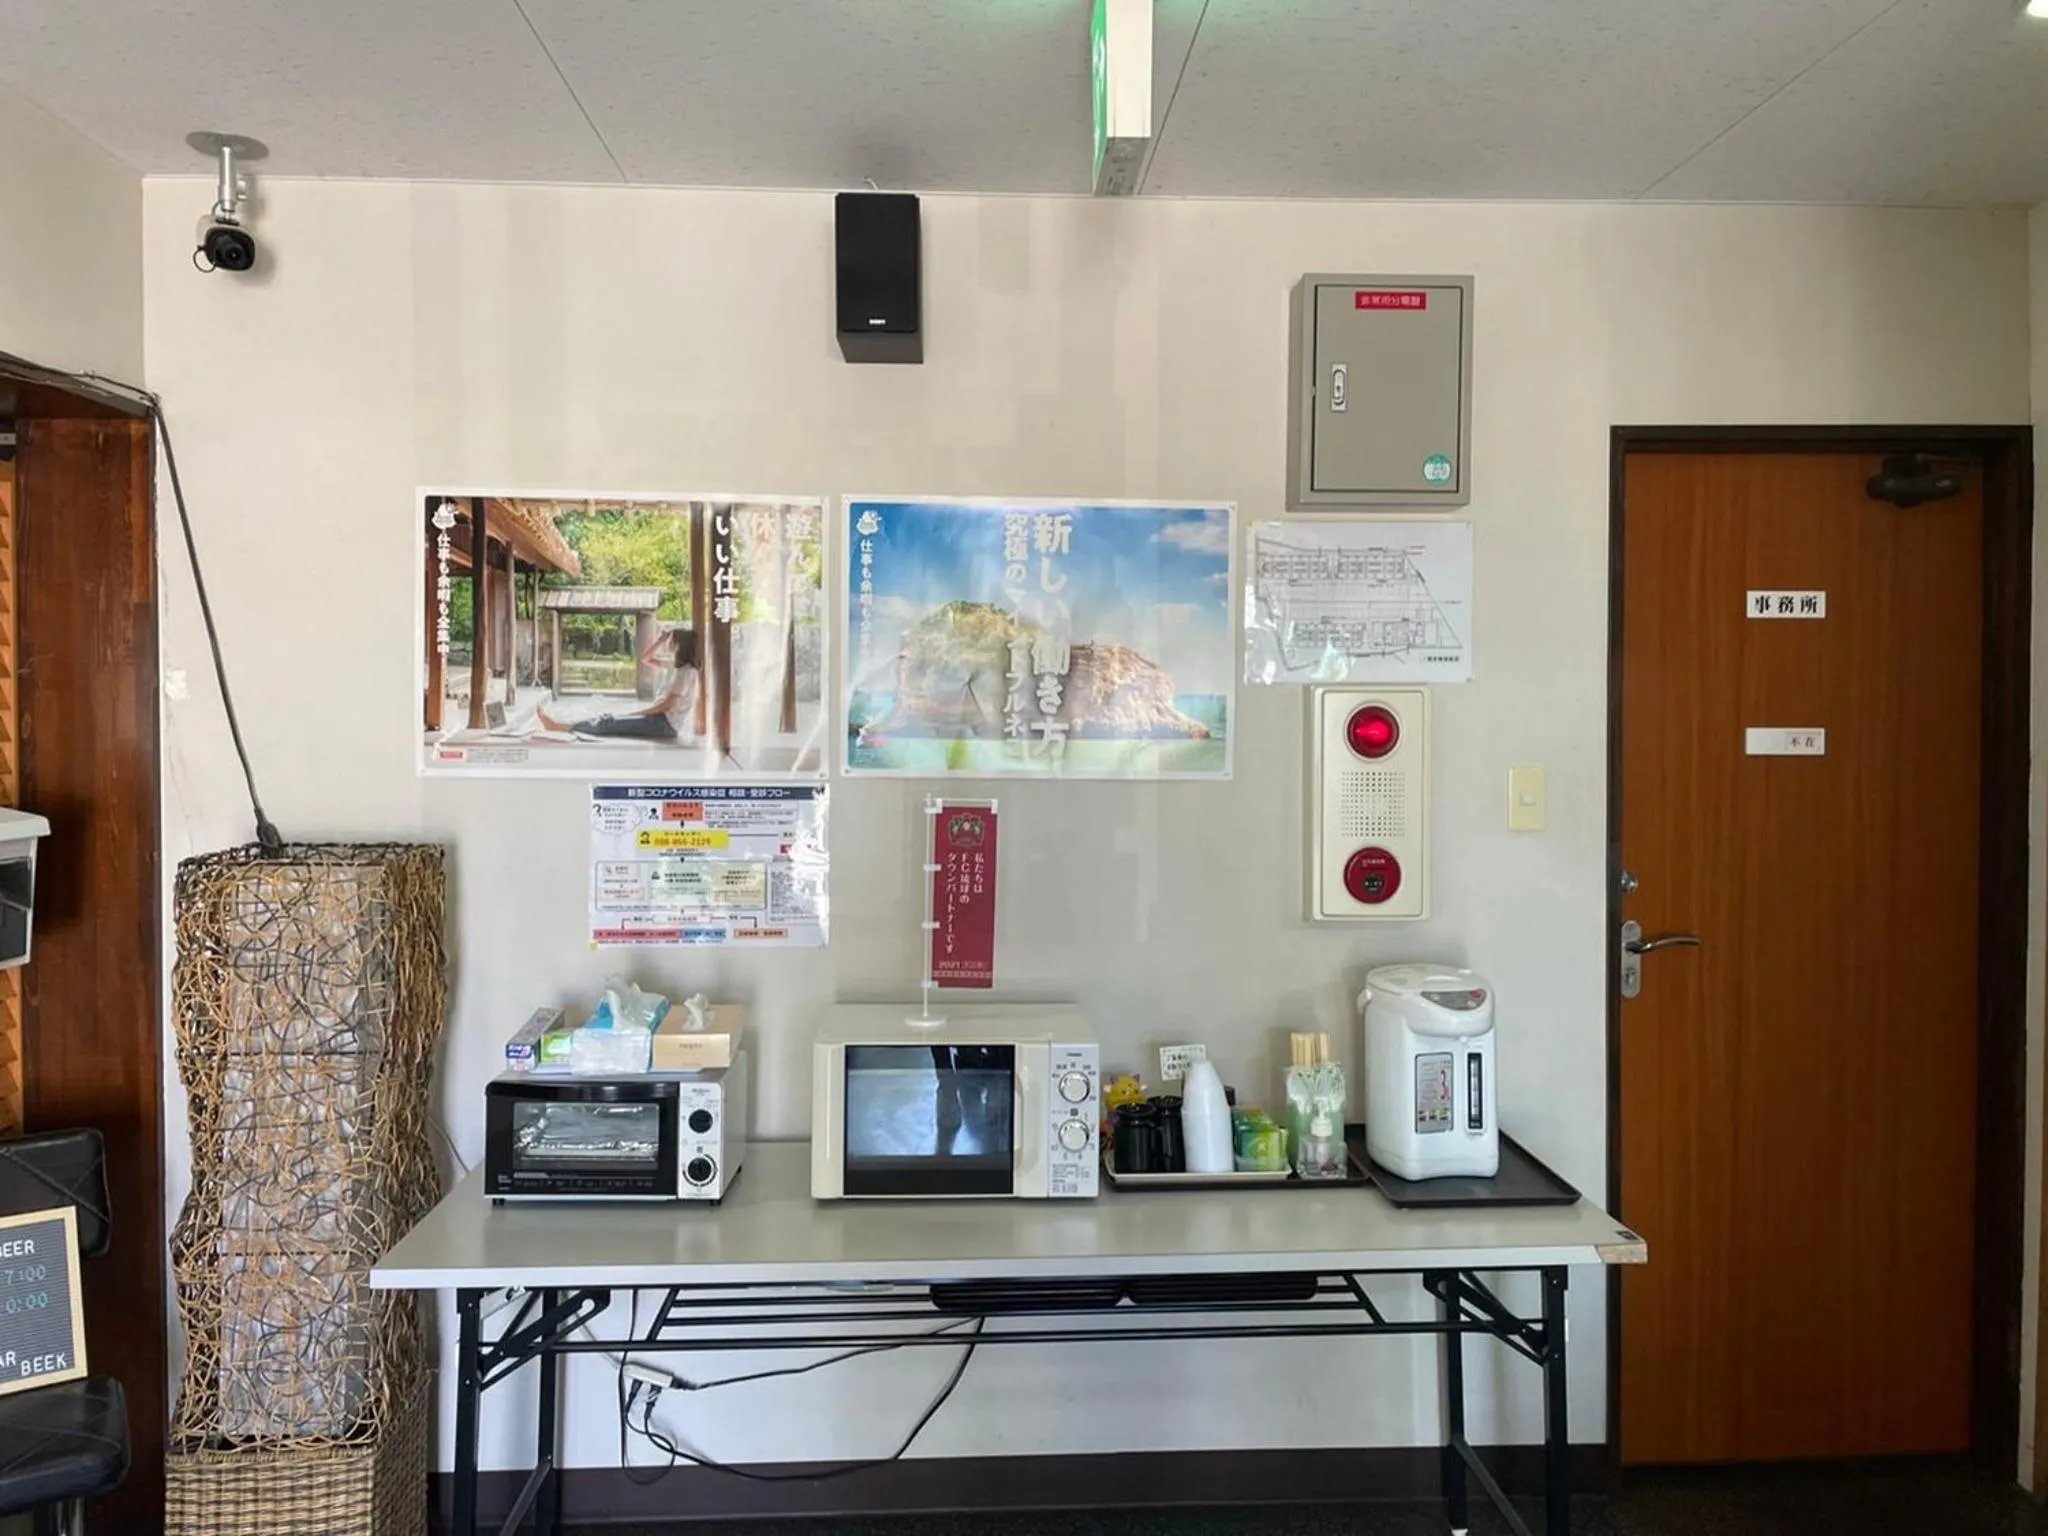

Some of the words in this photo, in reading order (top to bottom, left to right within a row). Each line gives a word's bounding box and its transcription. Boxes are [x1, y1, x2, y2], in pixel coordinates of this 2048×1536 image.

[1755, 595, 1817, 614] 事務所
[627, 788, 726, 798] 新型コロナウイルス感染症
[973, 853, 984, 893] 私たちは
[0, 1240, 35, 1259] EER
[21, 1352, 67, 1376] BEEK
